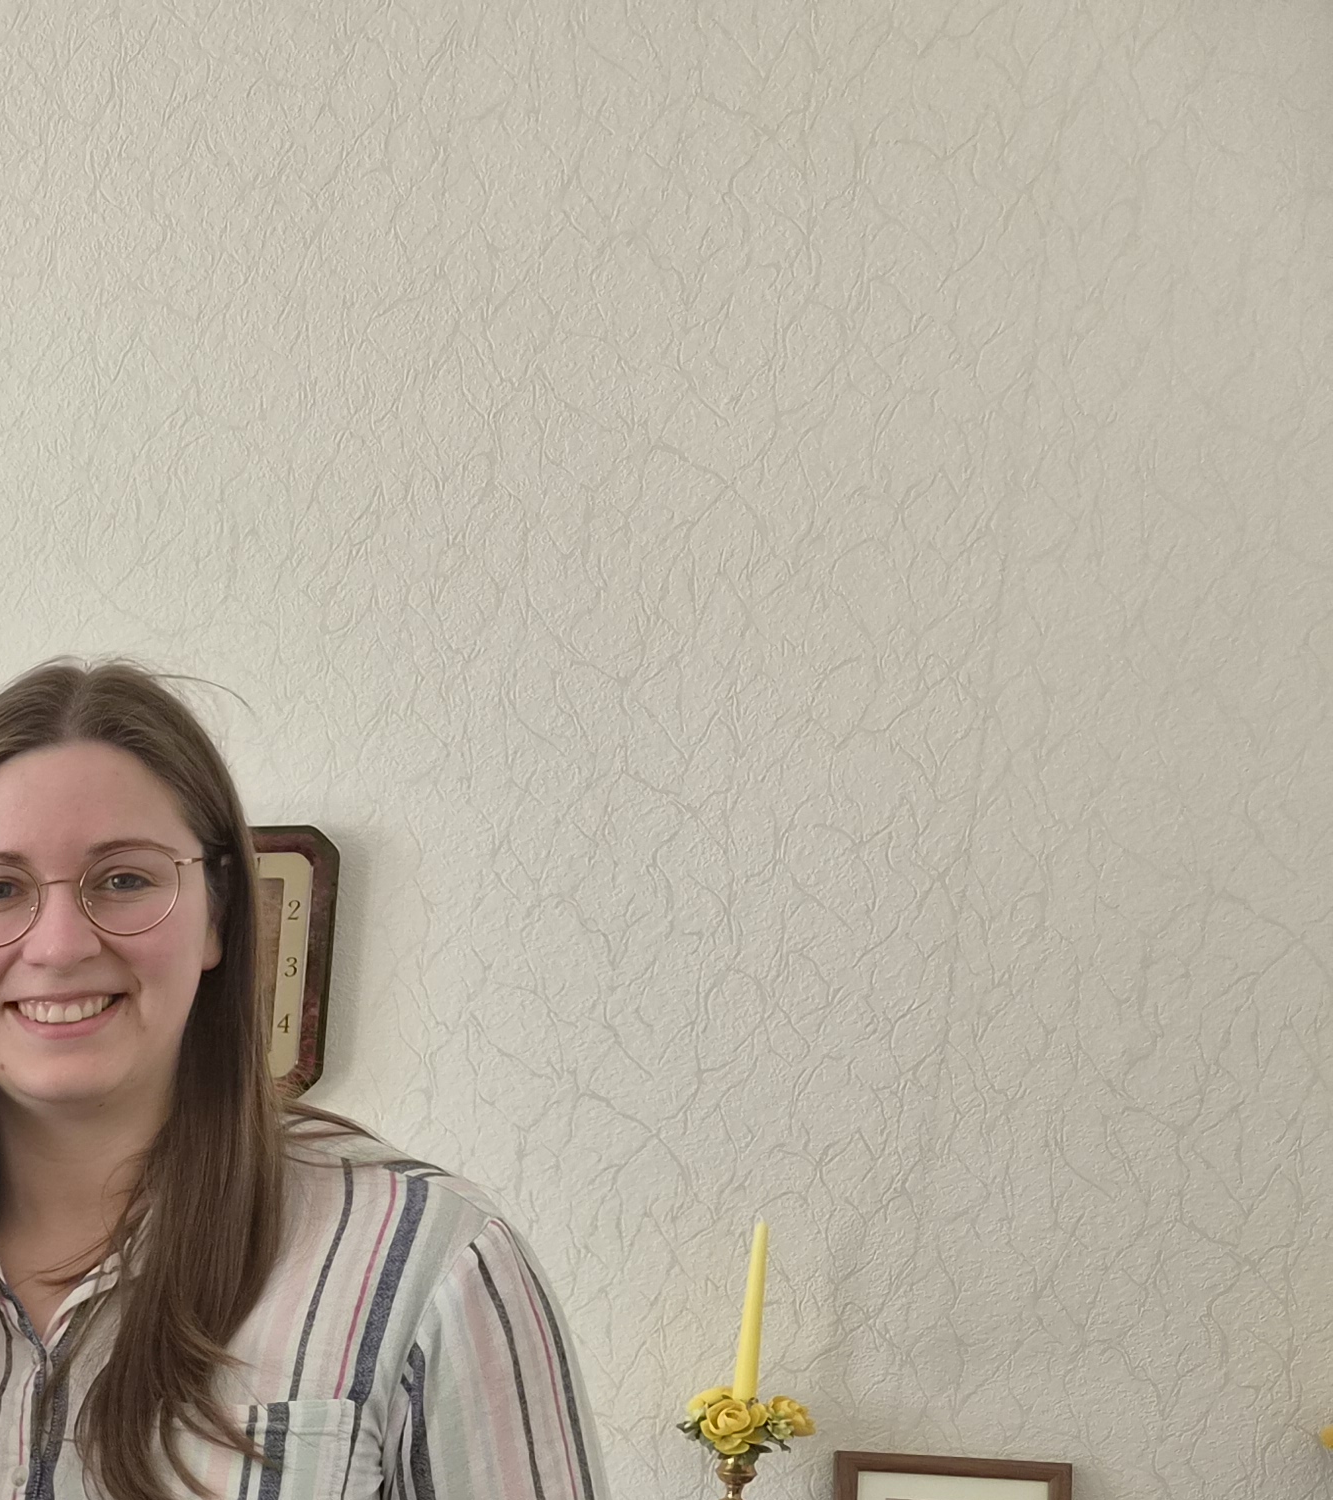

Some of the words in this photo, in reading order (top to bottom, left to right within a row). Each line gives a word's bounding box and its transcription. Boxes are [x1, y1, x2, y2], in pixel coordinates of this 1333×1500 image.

[287, 900, 301, 920] 2
[284, 957, 298, 978] 3
[277, 1013, 291, 1034] 4
